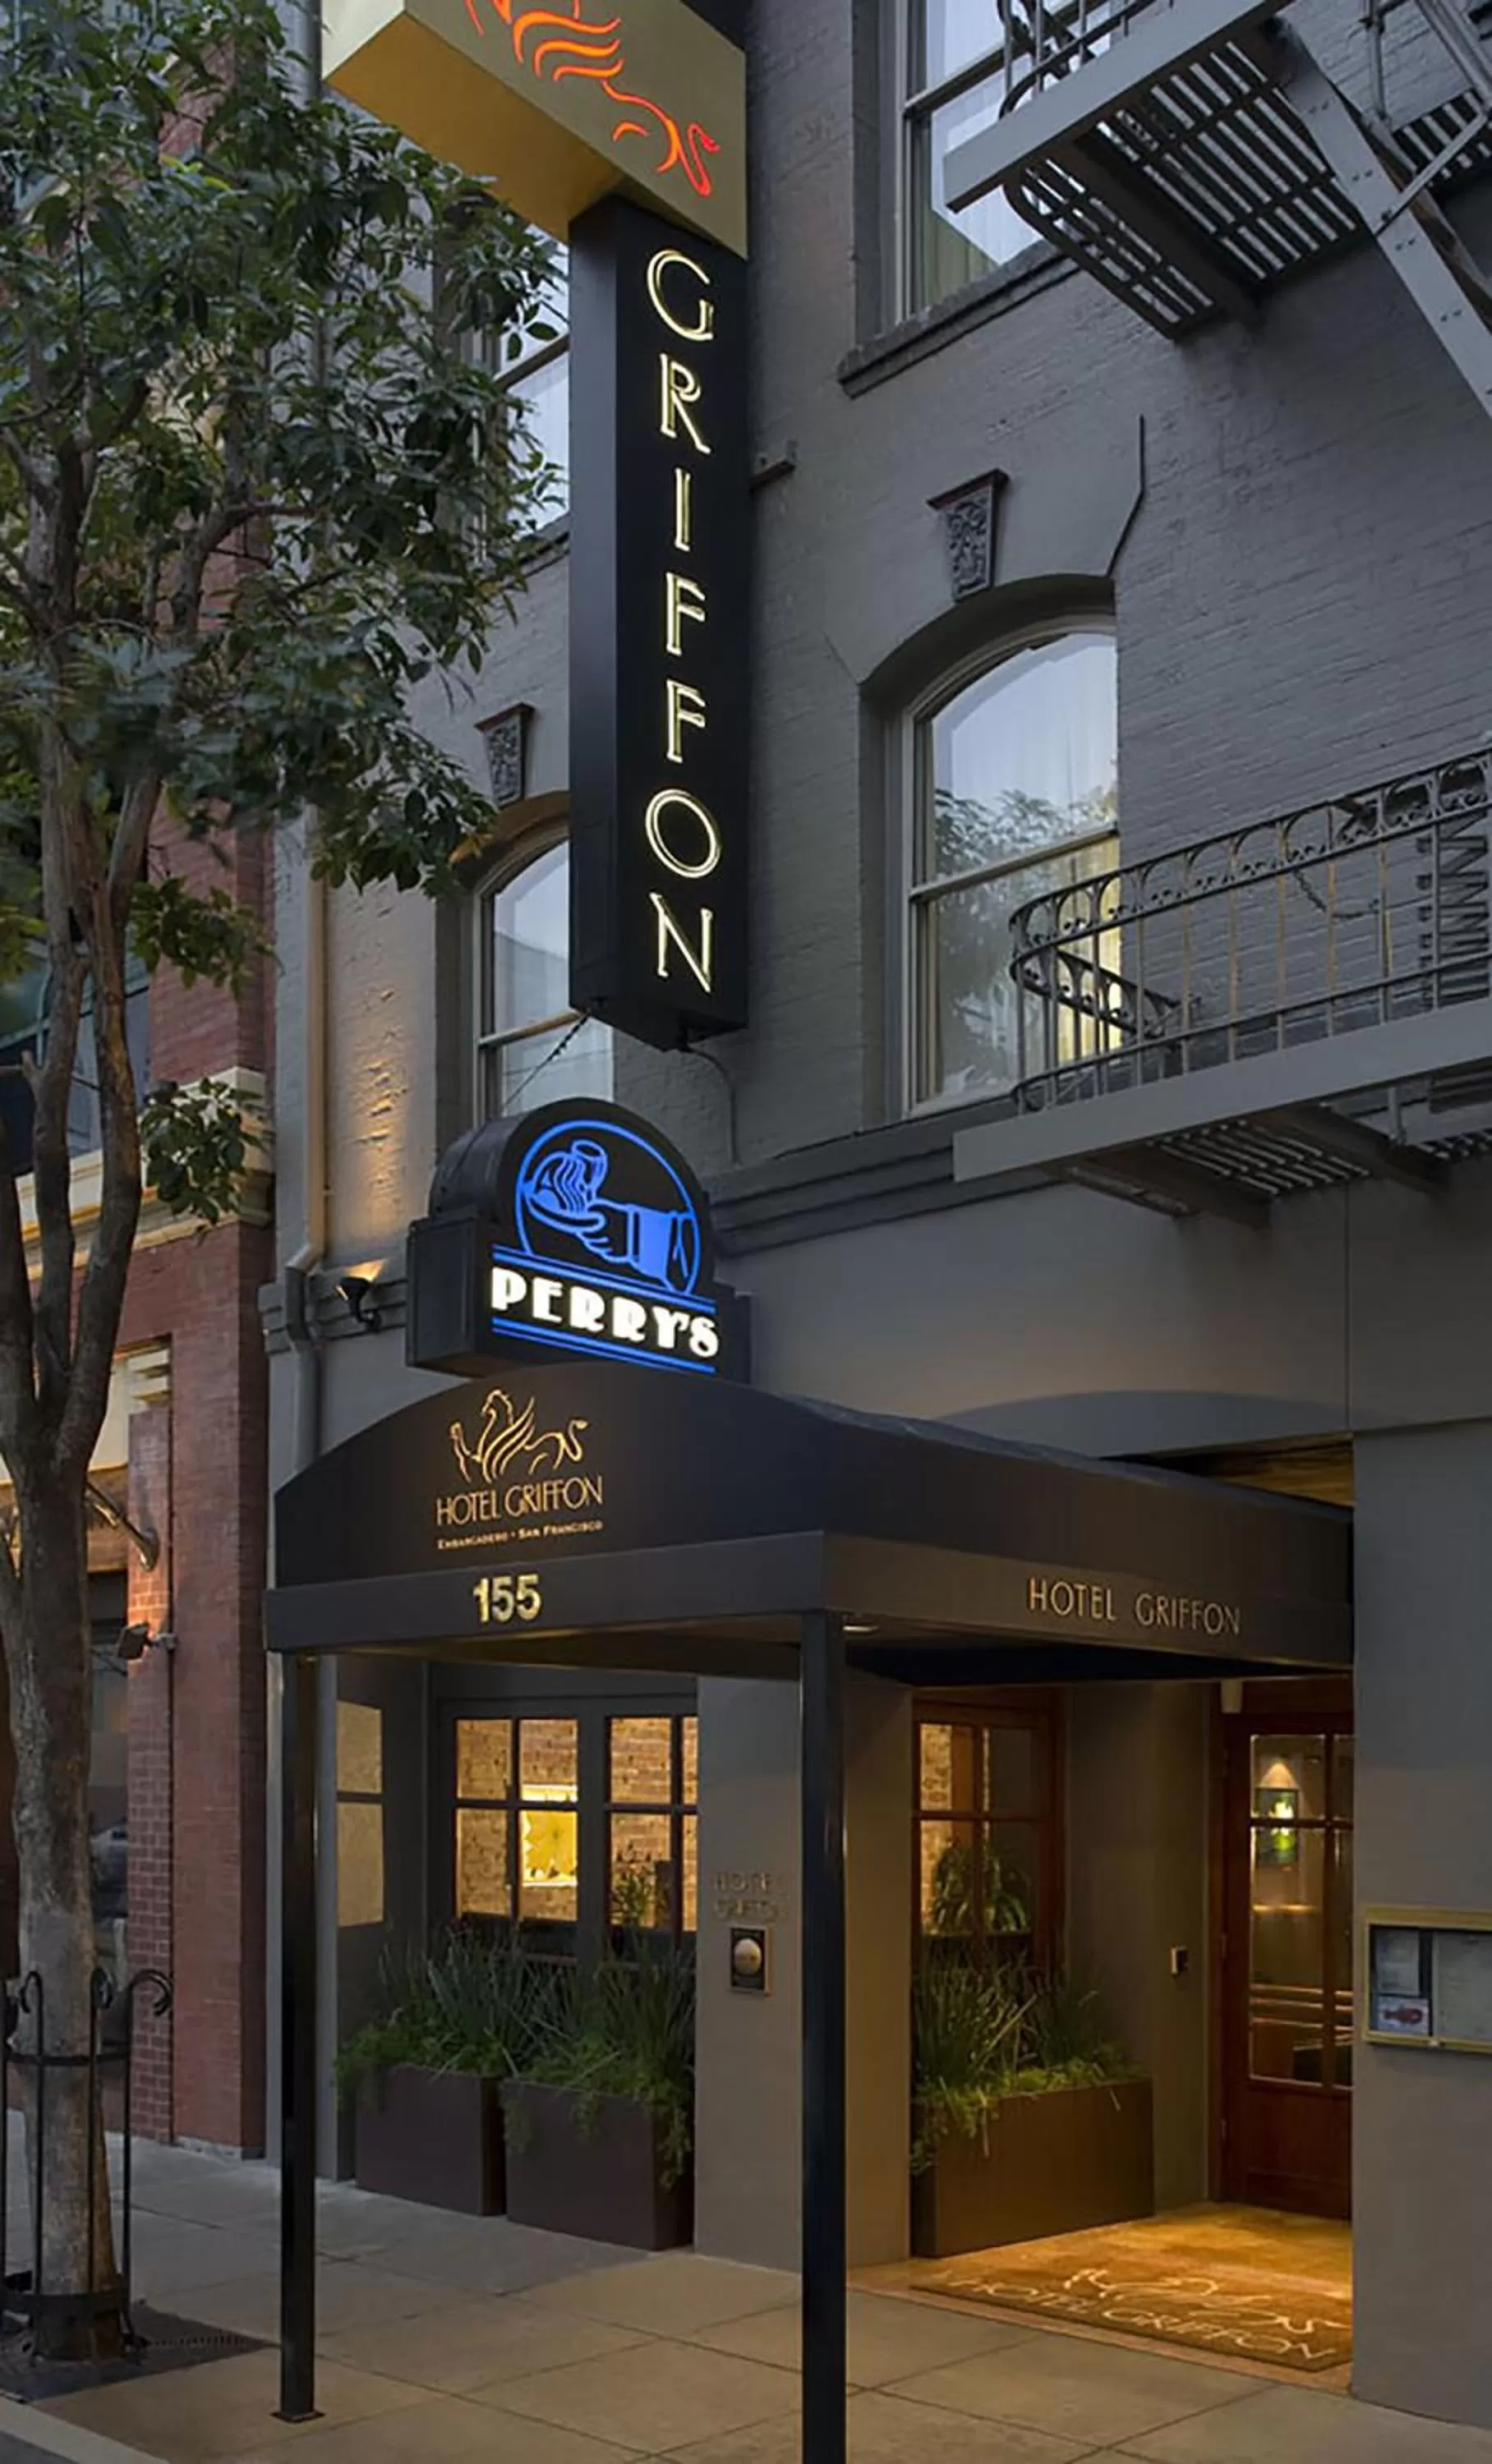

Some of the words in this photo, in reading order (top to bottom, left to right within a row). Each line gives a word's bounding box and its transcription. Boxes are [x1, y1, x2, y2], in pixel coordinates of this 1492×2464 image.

[646, 249, 721, 992] GRIFFON
[490, 1266, 720, 1358] PERRY'S
[436, 1490, 502, 1526] HOTEL
[504, 1475, 605, 1517] GRIFFON
[518, 1527, 541, 1539] SAN
[542, 1520, 604, 1538] FRANCISCO
[472, 1573, 542, 1623] 155
[1029, 1576, 1117, 1621] HOTEL
[1135, 1593, 1241, 1635] GRIFFON
